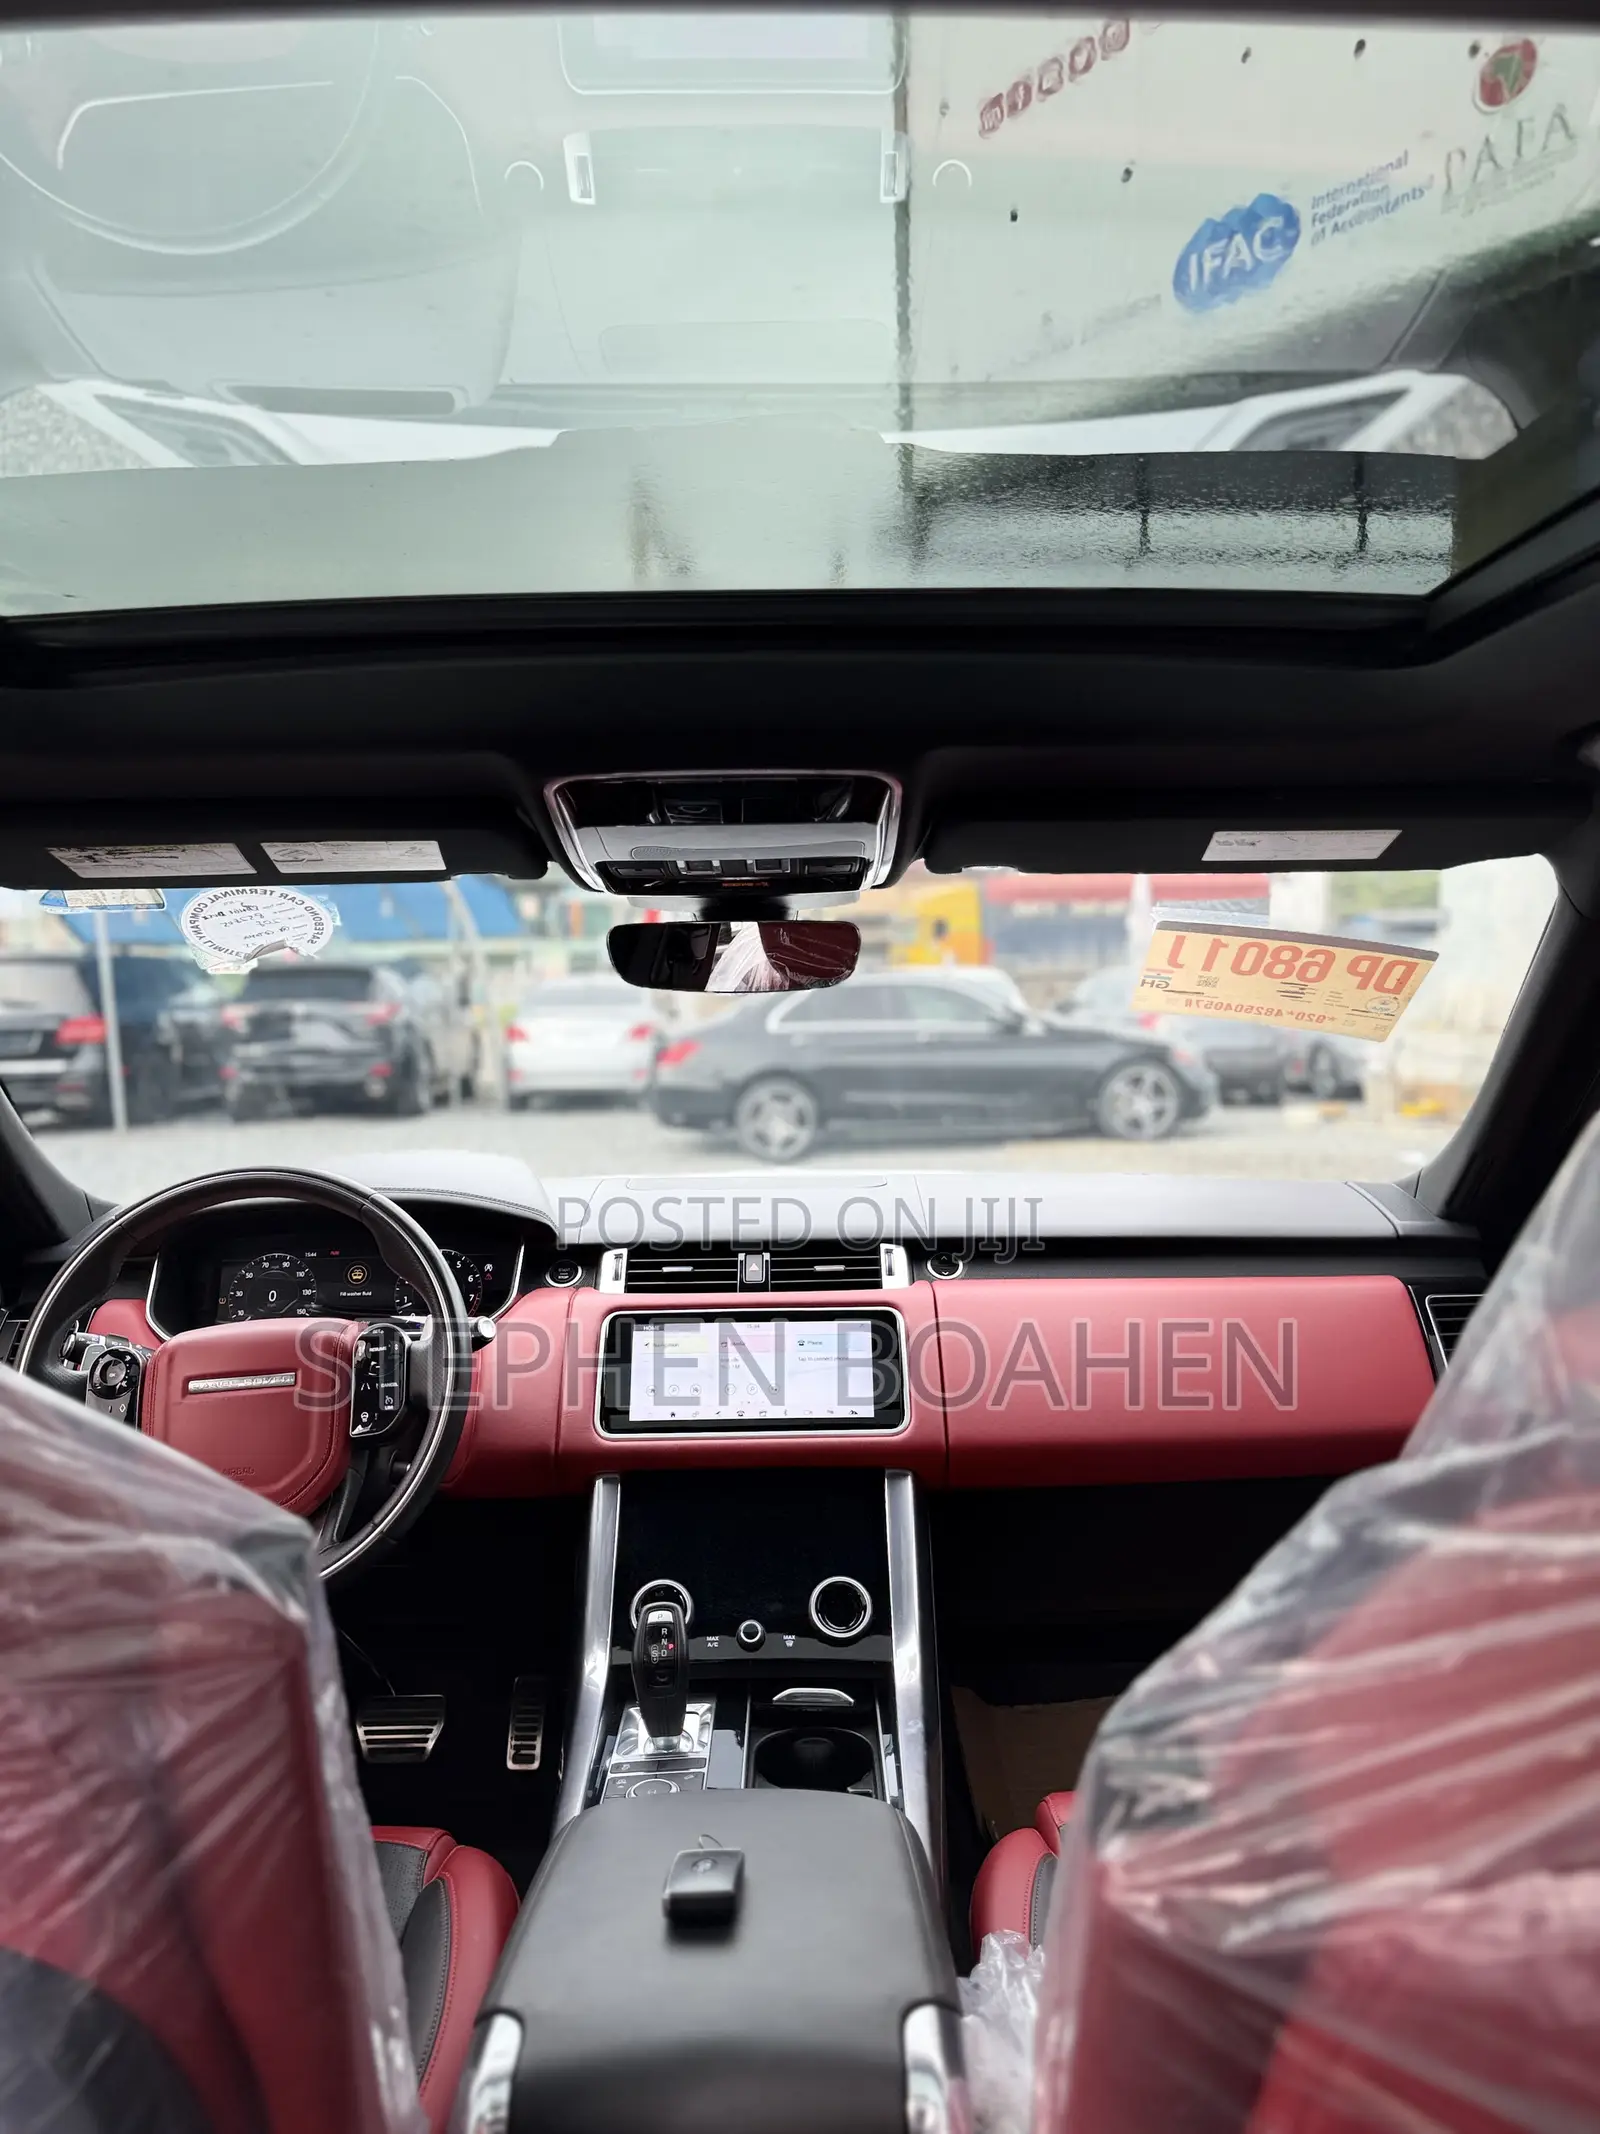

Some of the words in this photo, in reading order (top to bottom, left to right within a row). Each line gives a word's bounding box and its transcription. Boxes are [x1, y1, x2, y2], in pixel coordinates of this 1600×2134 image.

[1188, 215, 1284, 293] IFAC
[261, 1261, 270, 1269] 70
[282, 1261, 291, 1269] 90
[456, 1261, 462, 1269] 5
[268, 1290, 277, 1302] 0
[469, 1294, 475, 1302] 7
[661, 1627, 668, 1636] R
[661, 1638, 668, 1646] N
[661, 1649, 668, 1657] D
